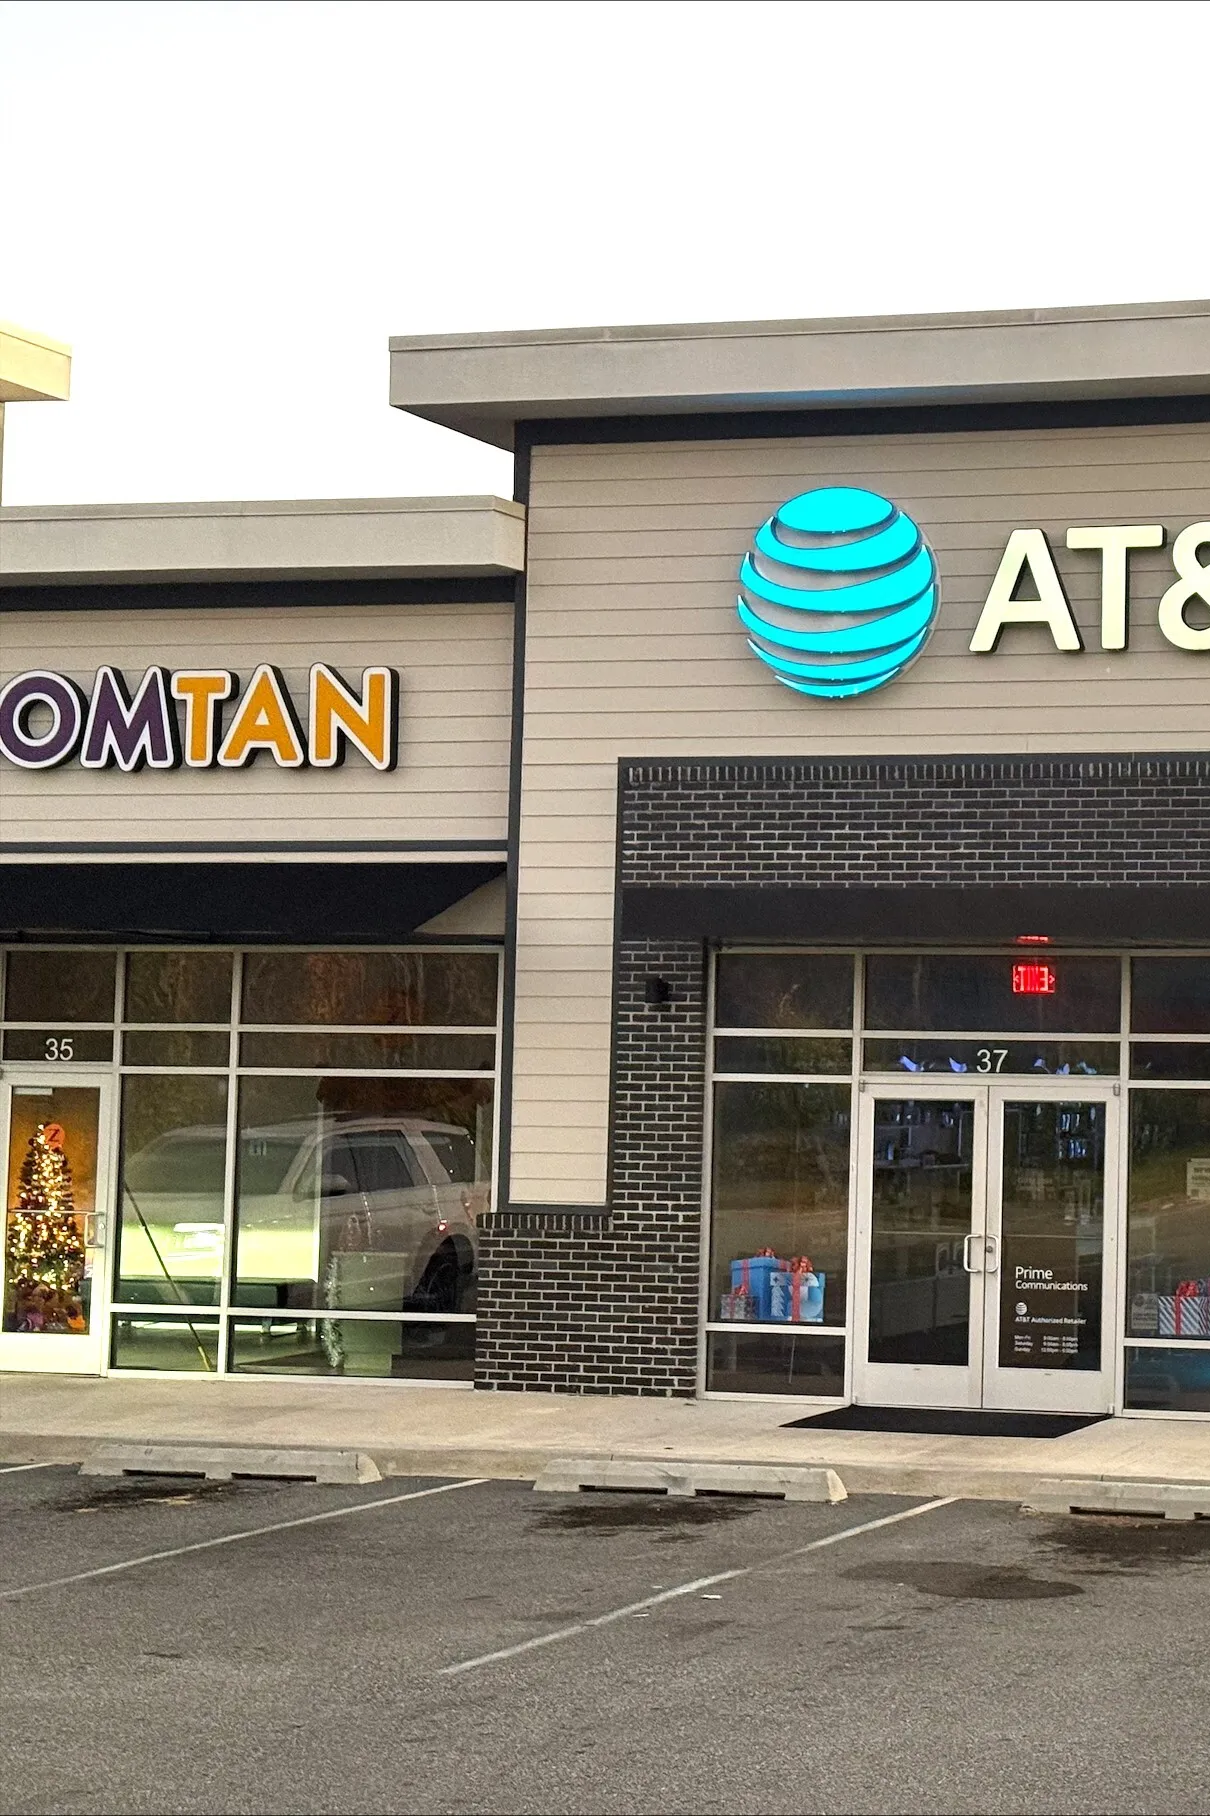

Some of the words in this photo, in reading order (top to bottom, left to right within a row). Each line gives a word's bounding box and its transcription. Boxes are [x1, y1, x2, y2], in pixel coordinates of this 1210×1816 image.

[45, 1038, 73, 1061] 35
[975, 1049, 1008, 1074] 37
[1015, 1266, 1053, 1280] Prime
[1015, 1280, 1088, 1291] Communications
[1063, 1317, 1087, 1325] Retailer
